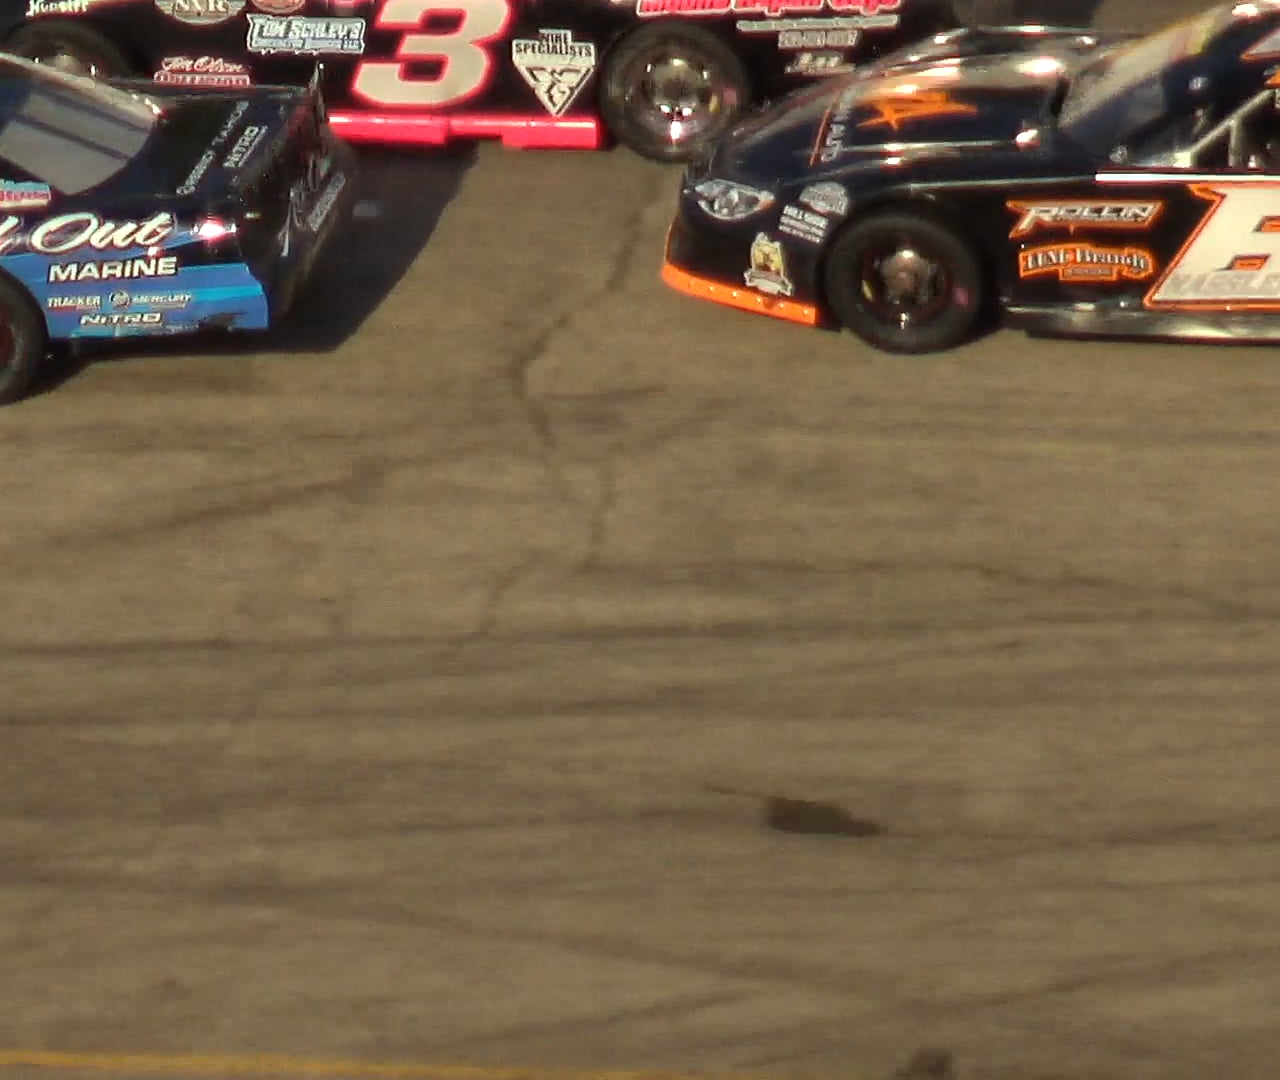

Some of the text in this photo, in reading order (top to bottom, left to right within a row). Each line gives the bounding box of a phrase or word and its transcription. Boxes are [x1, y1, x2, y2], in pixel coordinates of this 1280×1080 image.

[515, 42, 592, 57] SPECIALISTS
[31, 211, 175, 255] Out
[48, 256, 178, 283] MARINE
[48, 295, 102, 309] TRACKER
[80, 311, 162, 326] NITRO
